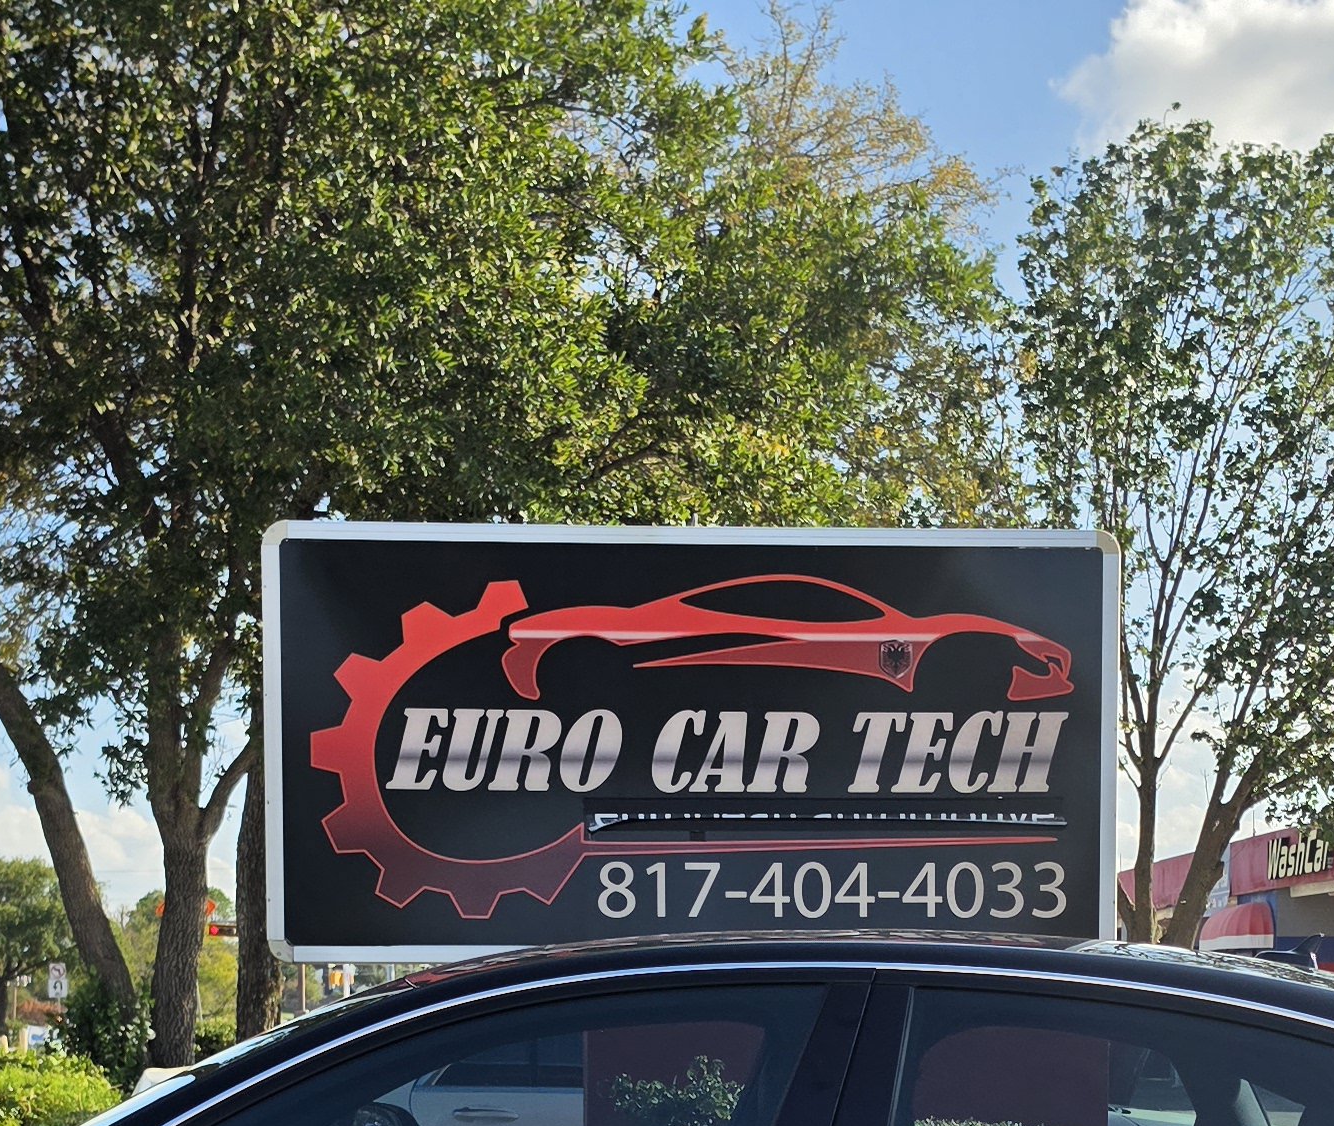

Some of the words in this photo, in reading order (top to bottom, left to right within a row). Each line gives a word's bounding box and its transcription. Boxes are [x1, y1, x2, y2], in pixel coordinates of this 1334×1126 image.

[385, 707, 624, 793] EURO
[651, 709, 821, 794] CAR
[847, 711, 1069, 794] TECH
[597, 861, 1067, 919] 817-404-4033
